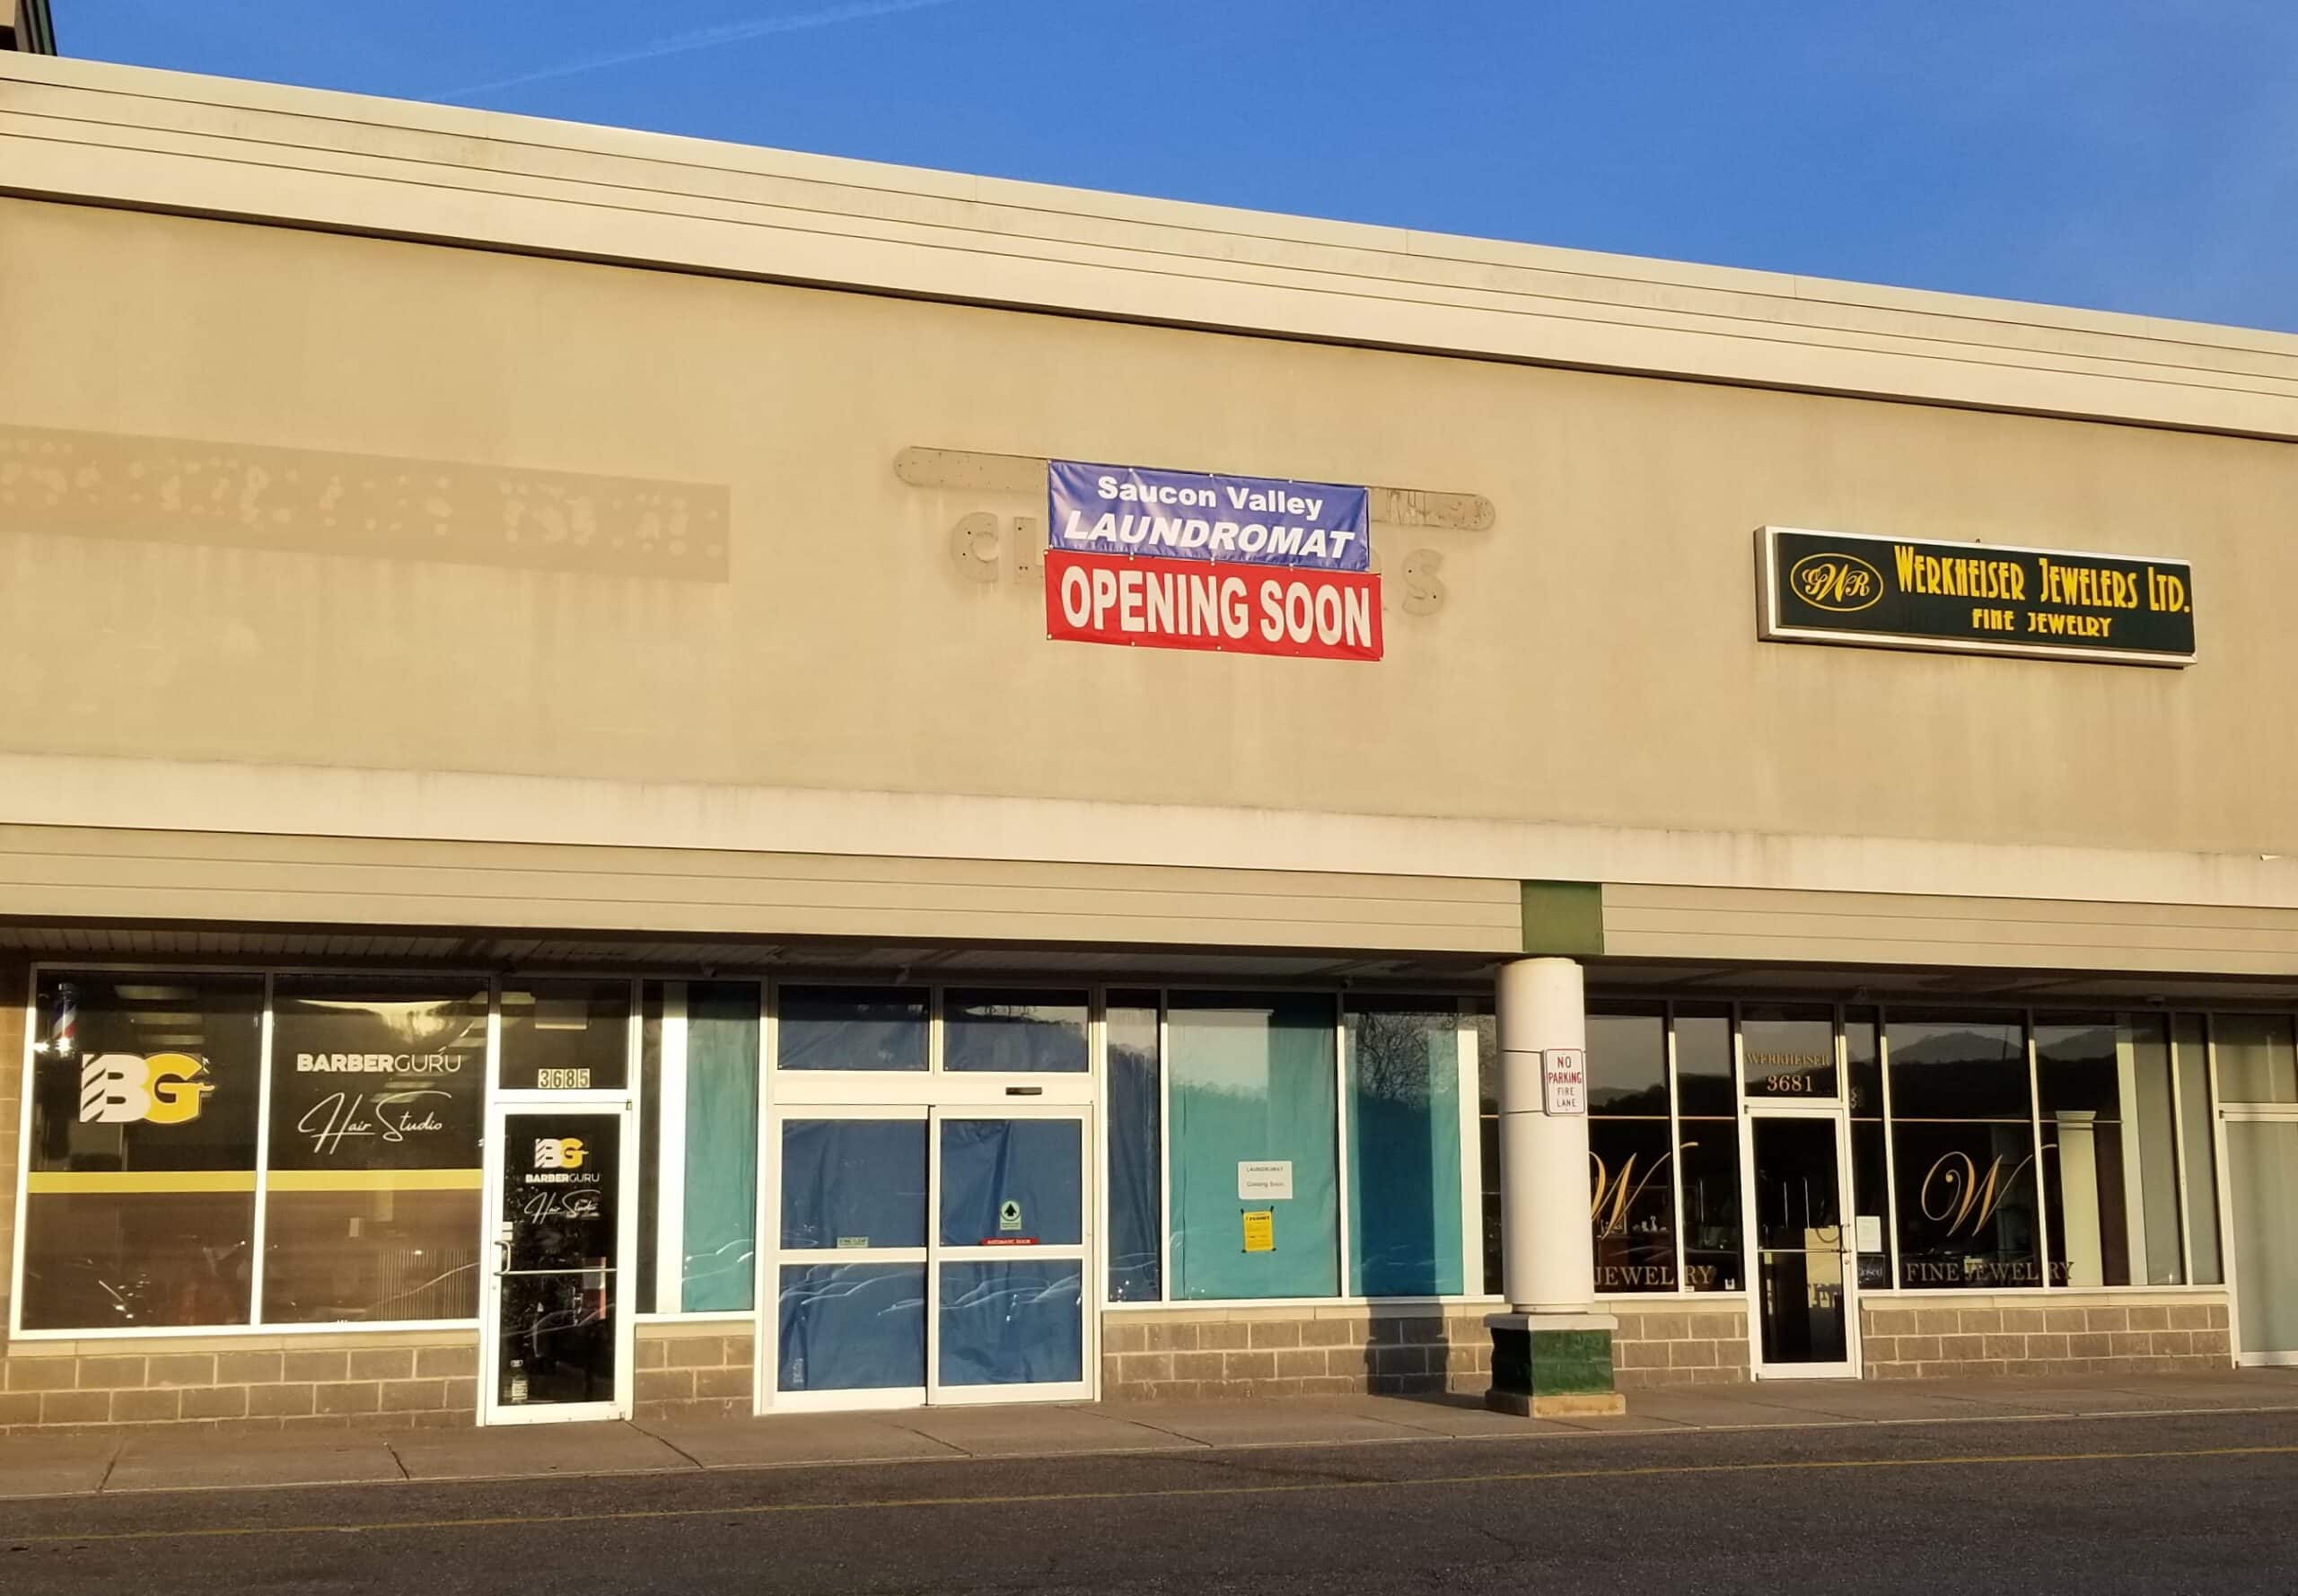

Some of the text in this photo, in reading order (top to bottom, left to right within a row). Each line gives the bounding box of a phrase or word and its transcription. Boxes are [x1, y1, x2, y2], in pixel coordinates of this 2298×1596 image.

[1098, 476, 1323, 522] Saucon Valley
[1065, 511, 1355, 559] LAUNDROMAT
[1894, 545, 2190, 613] WERKHEISER JEWELERS LTD.
[1061, 566, 1250, 639] OPENING
[1259, 579, 1373, 648] SOON
[1972, 609, 2112, 637] FINE JEWELRY
[296, 1053, 462, 1074] BARBERGURU
[1557, 1056, 1572, 1068] NO
[1745, 1052, 1830, 1066] WERKHEISER
[79, 1051, 215, 1125] BG
[539, 1069, 590, 1088] 3685
[1548, 1071, 1583, 1084] PARKING
[1767, 1074, 1813, 1092] 3681
[1557, 1087, 1575, 1096] FIRE
[1557, 1098, 1577, 1108] LANE
[298, 1090, 452, 1154] Hair Studio
[534, 1137, 589, 1169] BG
[525, 1173, 601, 1184] BARBERGURU
[1921, 1144, 2058, 1238] W
[523, 1191, 563, 1224] Hair
[1907, 1261, 2074, 1283] FINE JEWELRY
